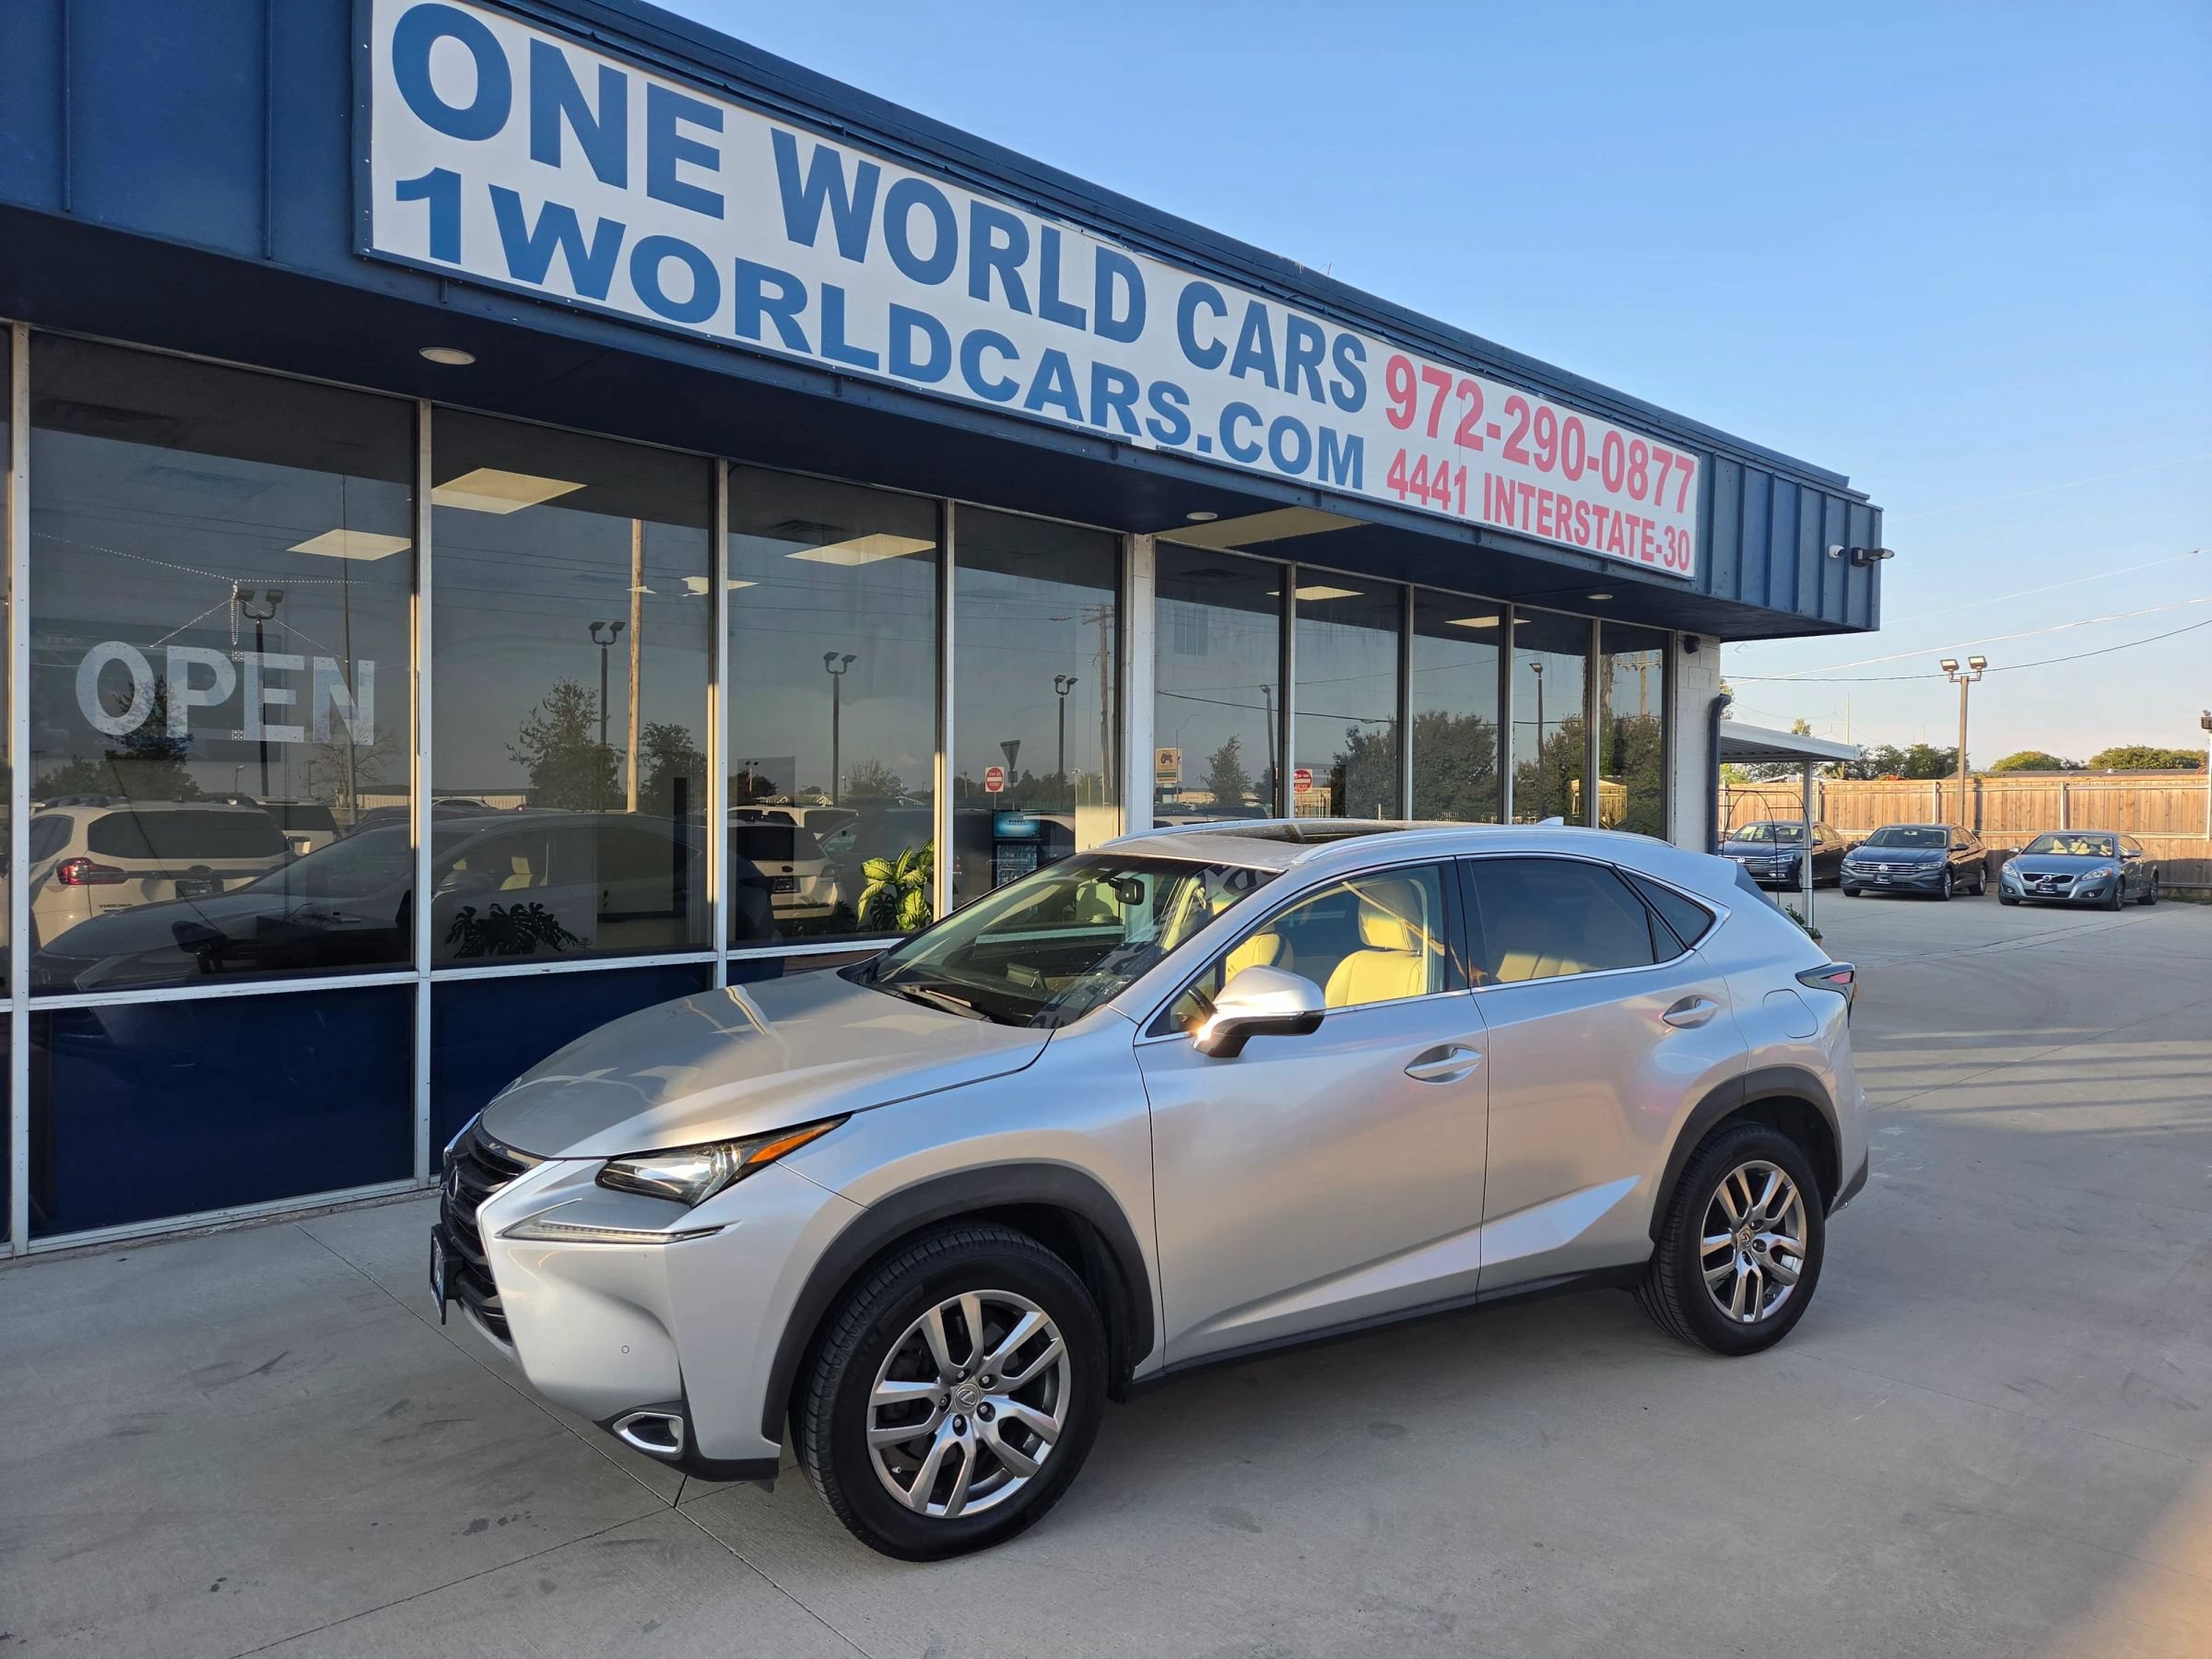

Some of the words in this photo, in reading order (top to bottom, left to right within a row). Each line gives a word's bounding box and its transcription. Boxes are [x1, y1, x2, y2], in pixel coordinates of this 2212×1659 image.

[393, 3, 724, 220] ONE
[771, 127, 1146, 344] WORLD
[1176, 280, 1367, 413] CARS
[395, 167, 1364, 490] 1WORLDCARS.COM
[1385, 354, 1695, 514] 972-290-0877
[1386, 448, 1467, 516] 4441
[1483, 472, 1691, 571] INTERSTATE-30
[76, 641, 375, 746] OPEN
